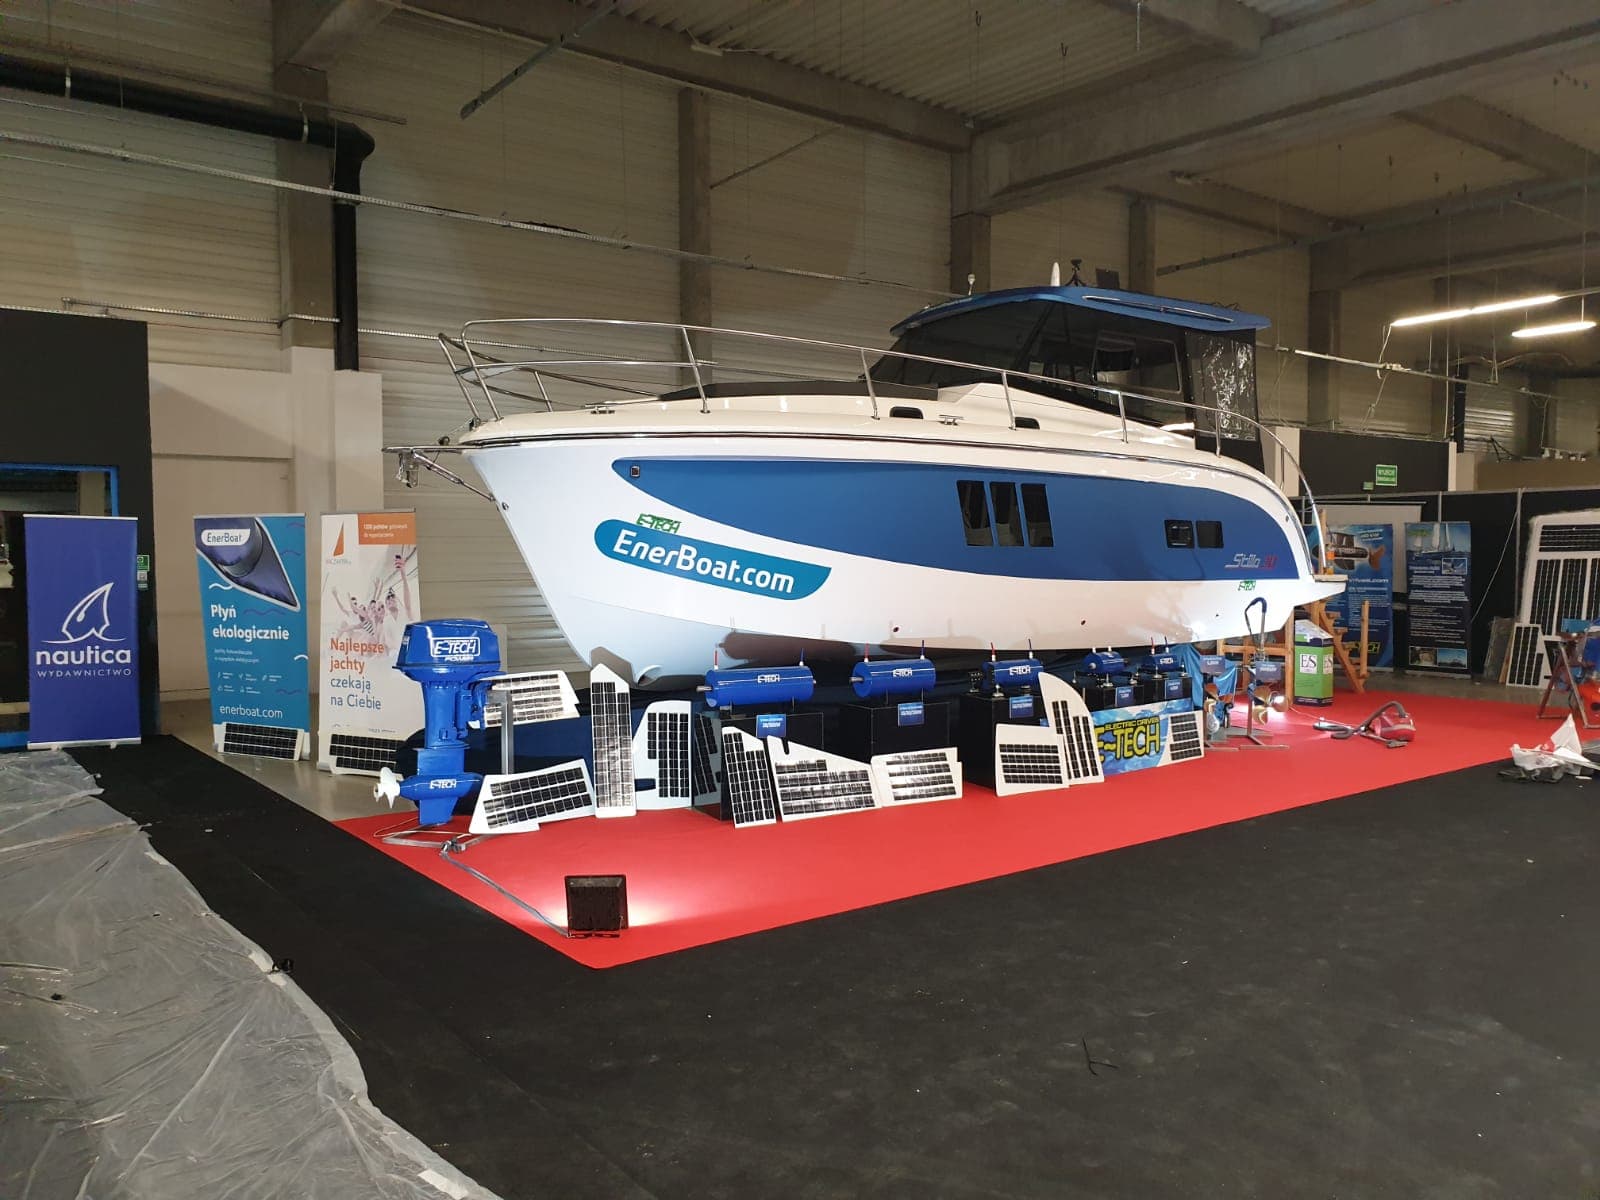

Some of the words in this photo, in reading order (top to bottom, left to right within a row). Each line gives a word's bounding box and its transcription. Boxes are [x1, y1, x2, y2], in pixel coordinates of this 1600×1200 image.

[636, 513, 682, 533] E-TECH
[207, 532, 242, 543] EnerBoat
[613, 528, 795, 593] EnerBoat.com
[210, 604, 237, 622] Płyń
[212, 624, 290, 643] ekologicznie
[35, 645, 131, 665] nautica
[330, 638, 384, 655] Najlepsze
[434, 640, 477, 654] E-TECH
[37, 668, 131, 678] WYDAWNICTWO
[329, 656, 365, 674] jachty
[330, 675, 371, 693] czekają
[330, 695, 343, 706] na
[346, 694, 382, 710] Ciebie
[219, 705, 283, 719] enerboat.com
[1104, 720, 1137, 731] ELECTRIC
[1094, 723, 1160, 762] E-TECH
[429, 779, 457, 790] E-TECH
